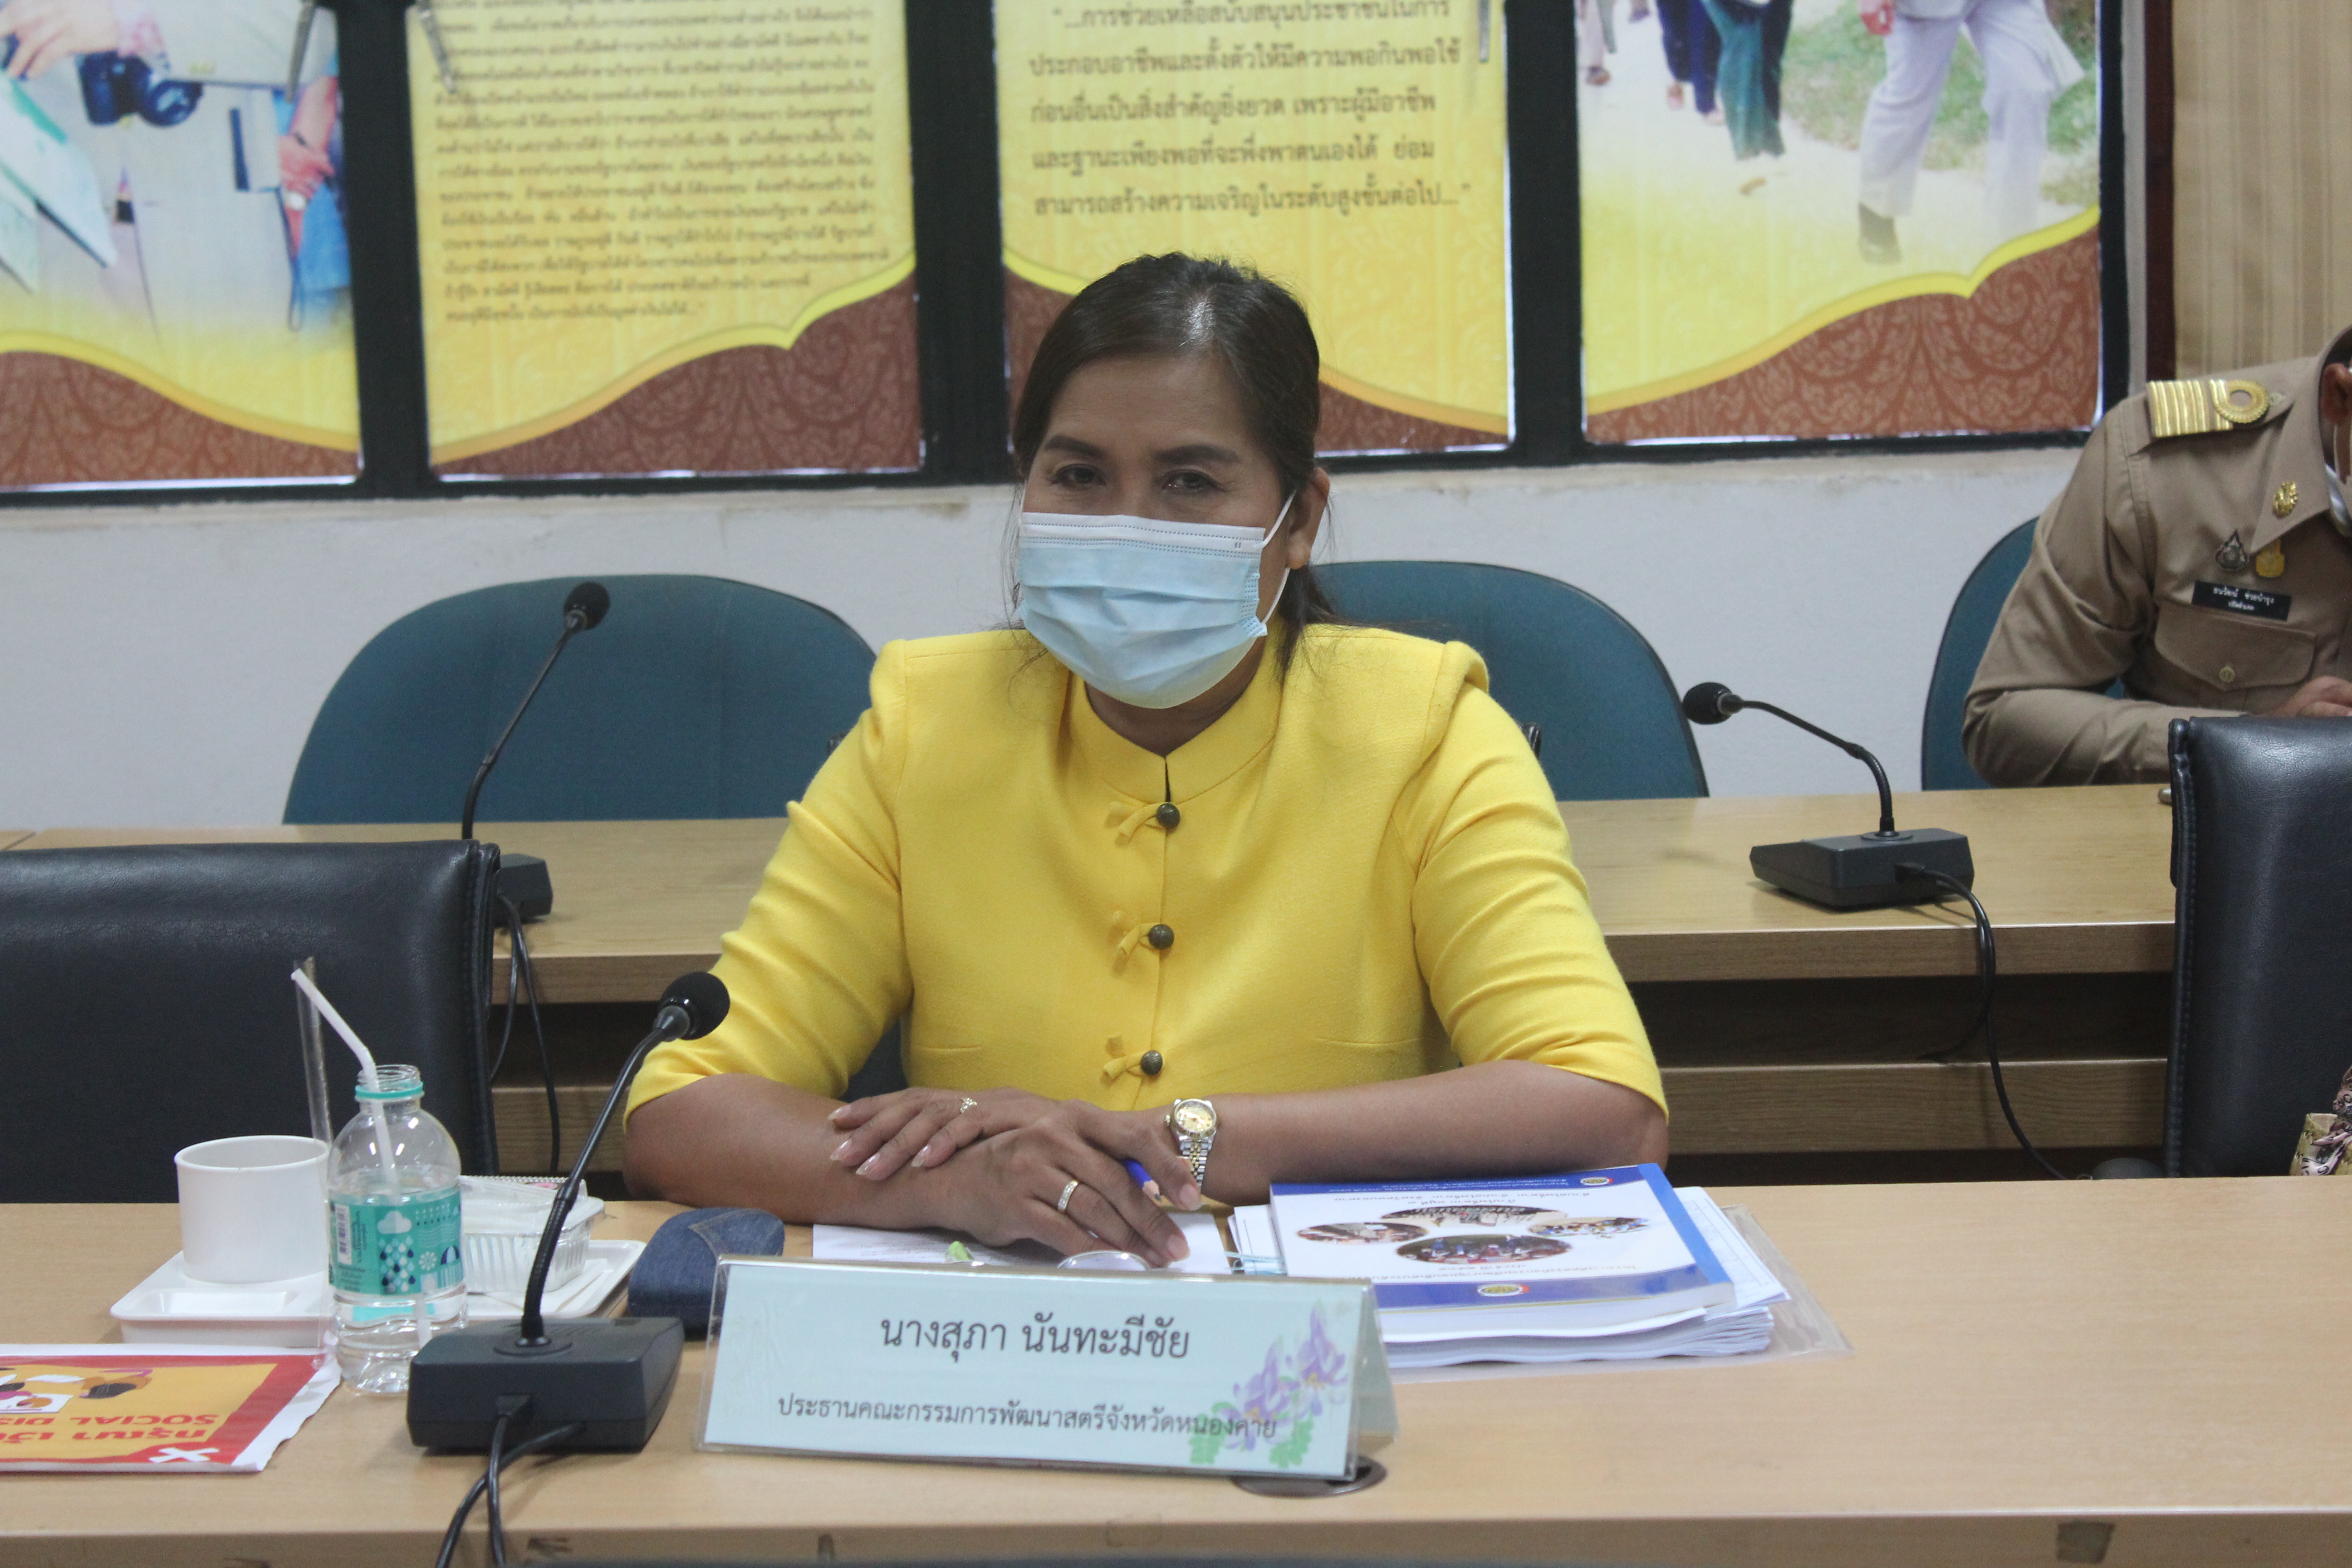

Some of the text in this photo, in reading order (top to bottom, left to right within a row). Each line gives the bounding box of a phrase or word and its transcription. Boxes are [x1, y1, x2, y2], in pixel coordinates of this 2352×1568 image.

[1293, 86, 1436, 122] เพราะผู้มีอาชีพ
[1393, 135, 1435, 159] ย่อม
[881, 1312, 1190, 1365] นางสุภา นันทะมีชัย
[70, 1414, 220, 1426] SOCIAL
[778, 1391, 1277, 1439] ประธานคณะกรรมการพัฒนาสตรีจังหวัดหนองคาย
[71, 1427, 206, 1441] กรุณา
